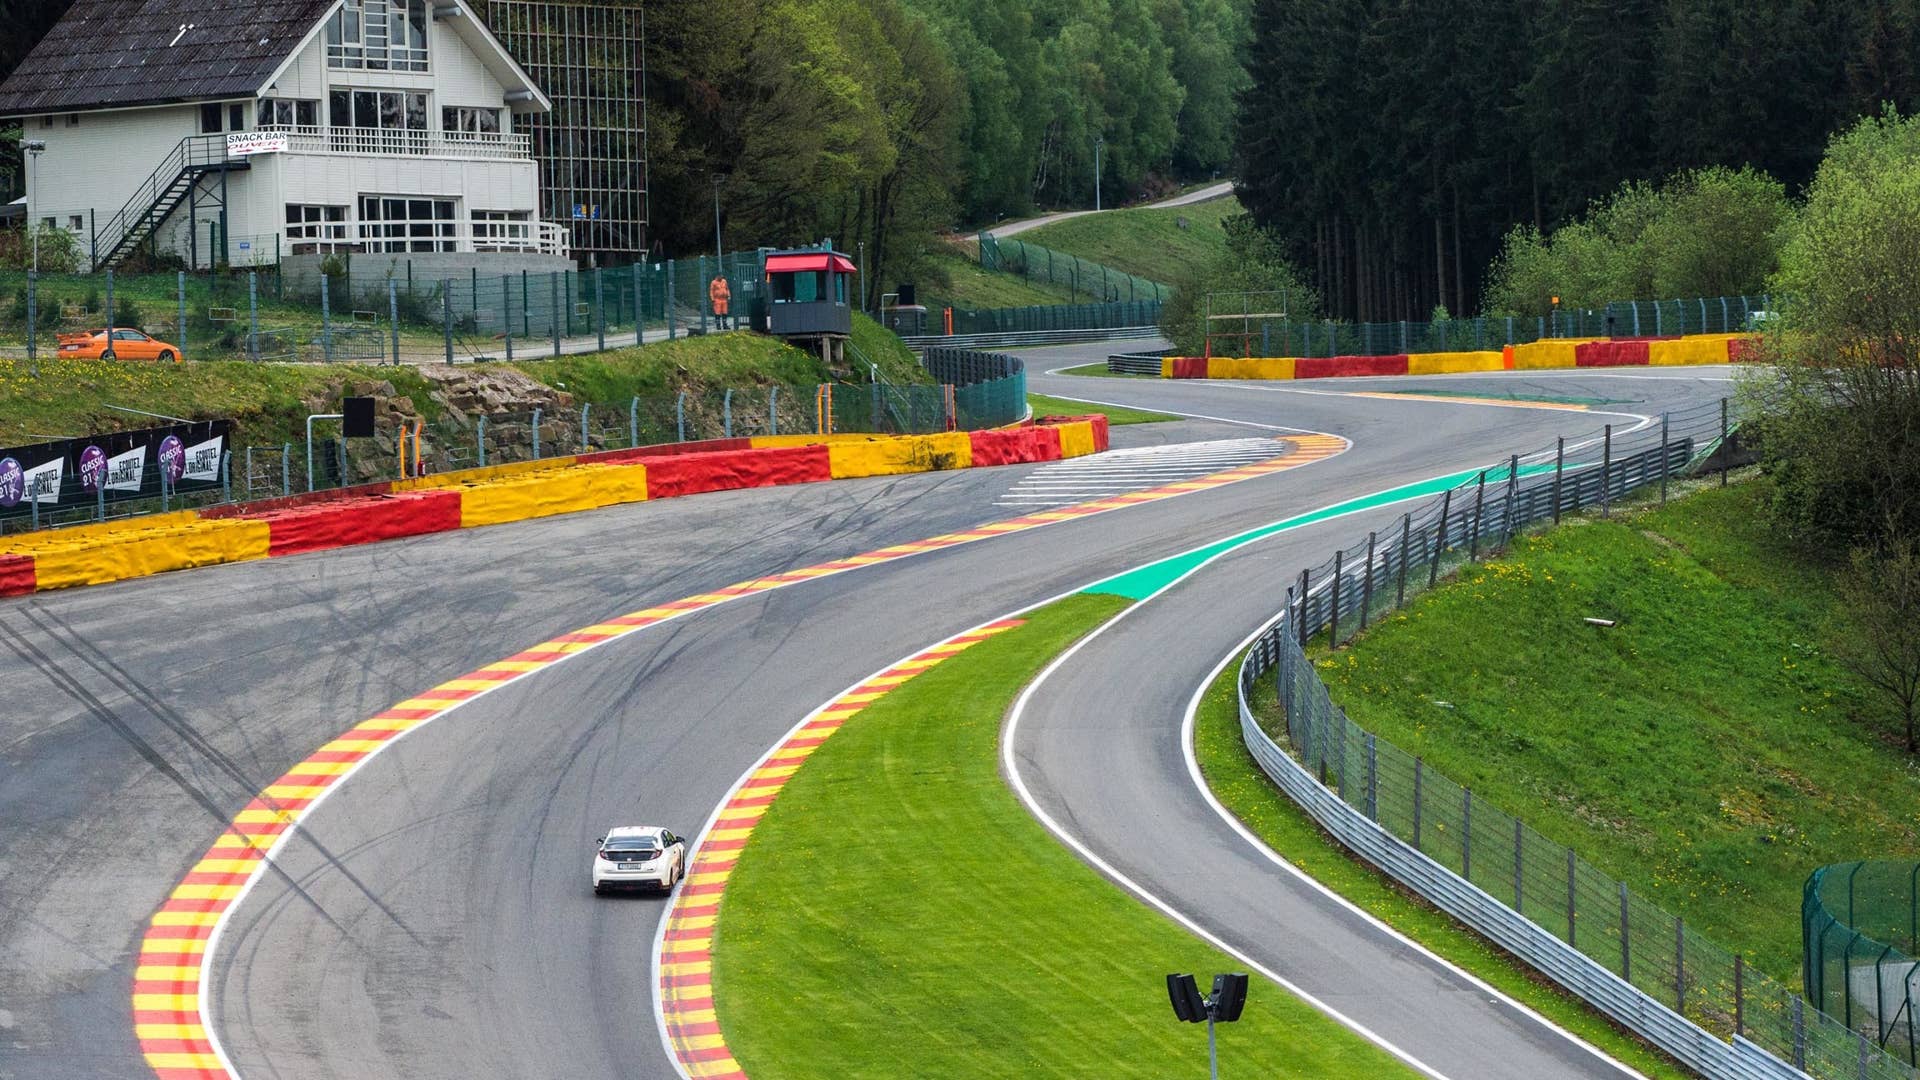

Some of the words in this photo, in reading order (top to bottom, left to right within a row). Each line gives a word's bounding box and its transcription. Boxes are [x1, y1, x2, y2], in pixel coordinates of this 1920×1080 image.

[227, 140, 286, 149] OUVERT
[228, 133, 264, 143] SNACK
[265, 132, 286, 140] BAR
[160, 444, 182, 463] CLASSIC
[81, 455, 104, 473] CLASSIC
[0, 466, 20, 485] LASSIC
[82, 473, 93, 487] 21
